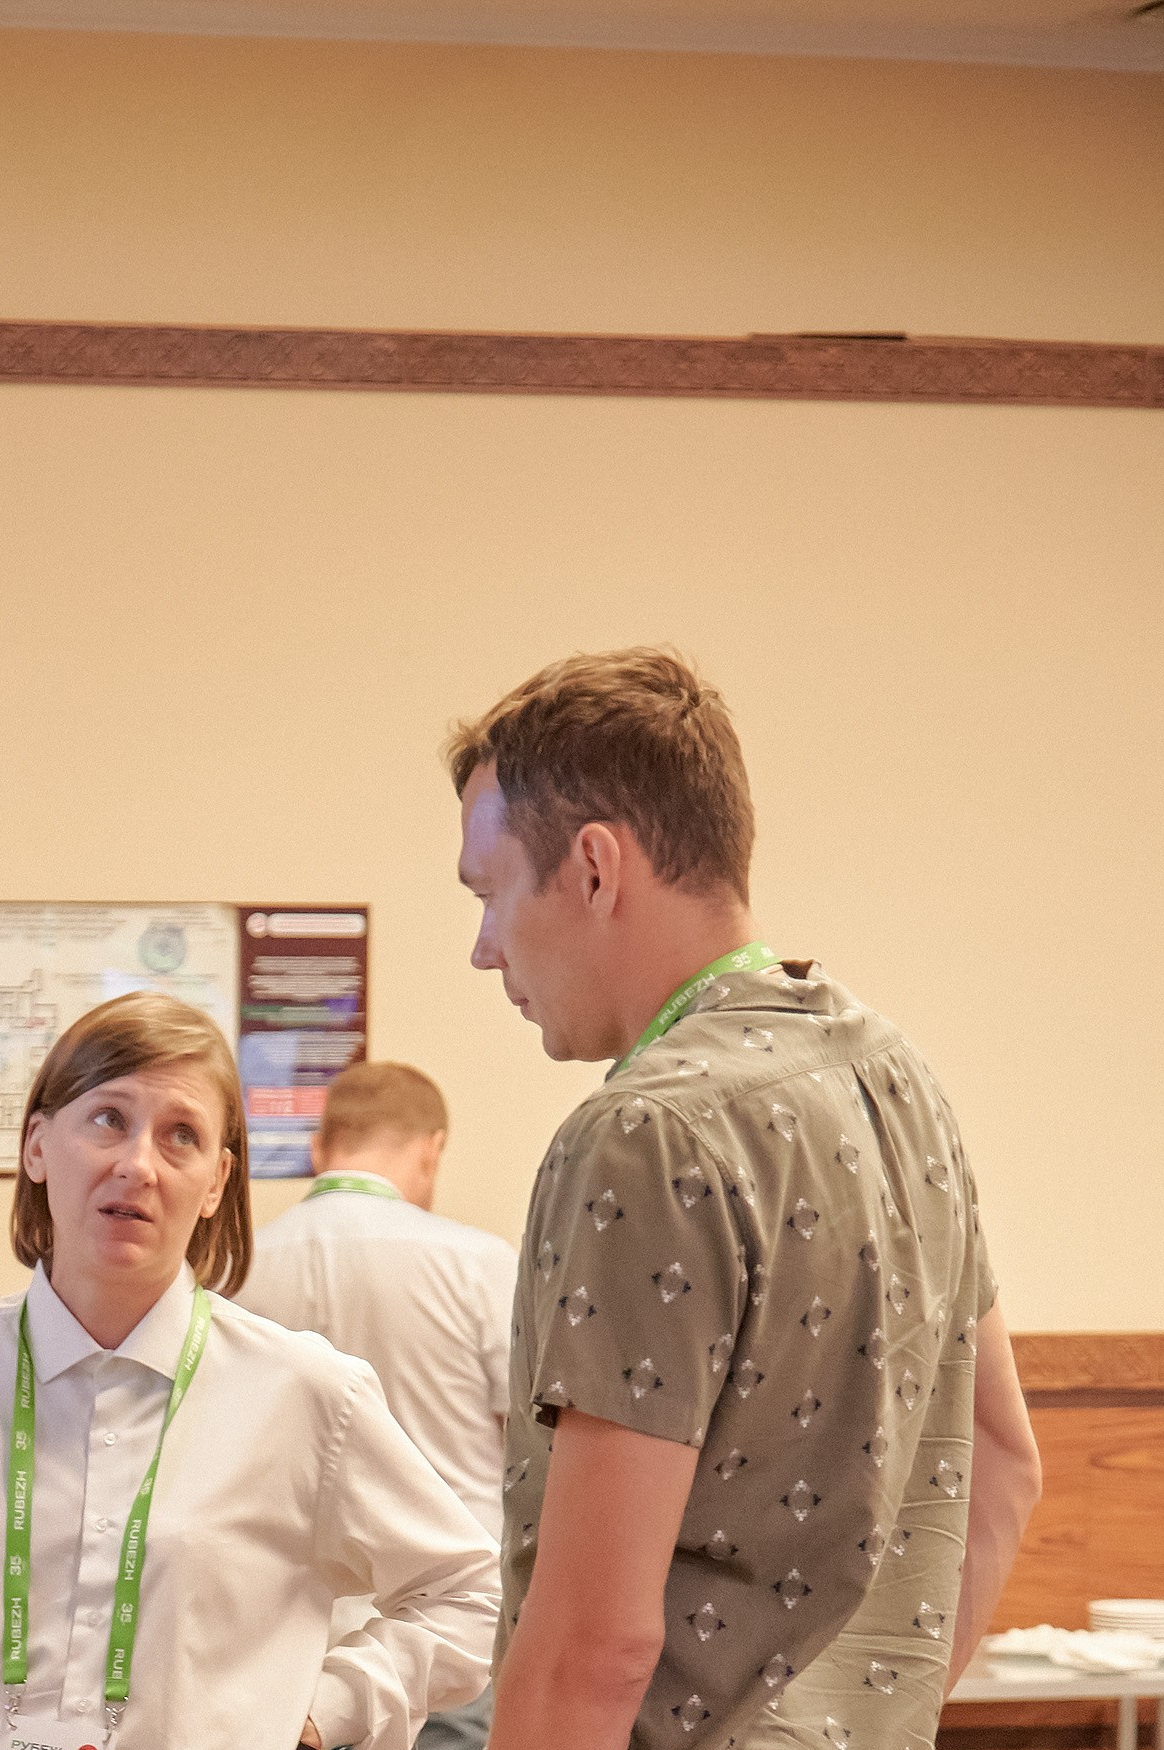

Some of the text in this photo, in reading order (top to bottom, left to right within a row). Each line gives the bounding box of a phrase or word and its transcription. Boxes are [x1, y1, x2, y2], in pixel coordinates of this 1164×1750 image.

[184, 1315, 206, 1371] RUBEZH
[15, 1430, 27, 1451] 35
[13, 1470, 27, 1531] RUBEZH
[9, 1554, 23, 1576] 35
[124, 1518, 143, 1581] RUBEZH
[11, 1597, 22, 1661] RUBEZH
